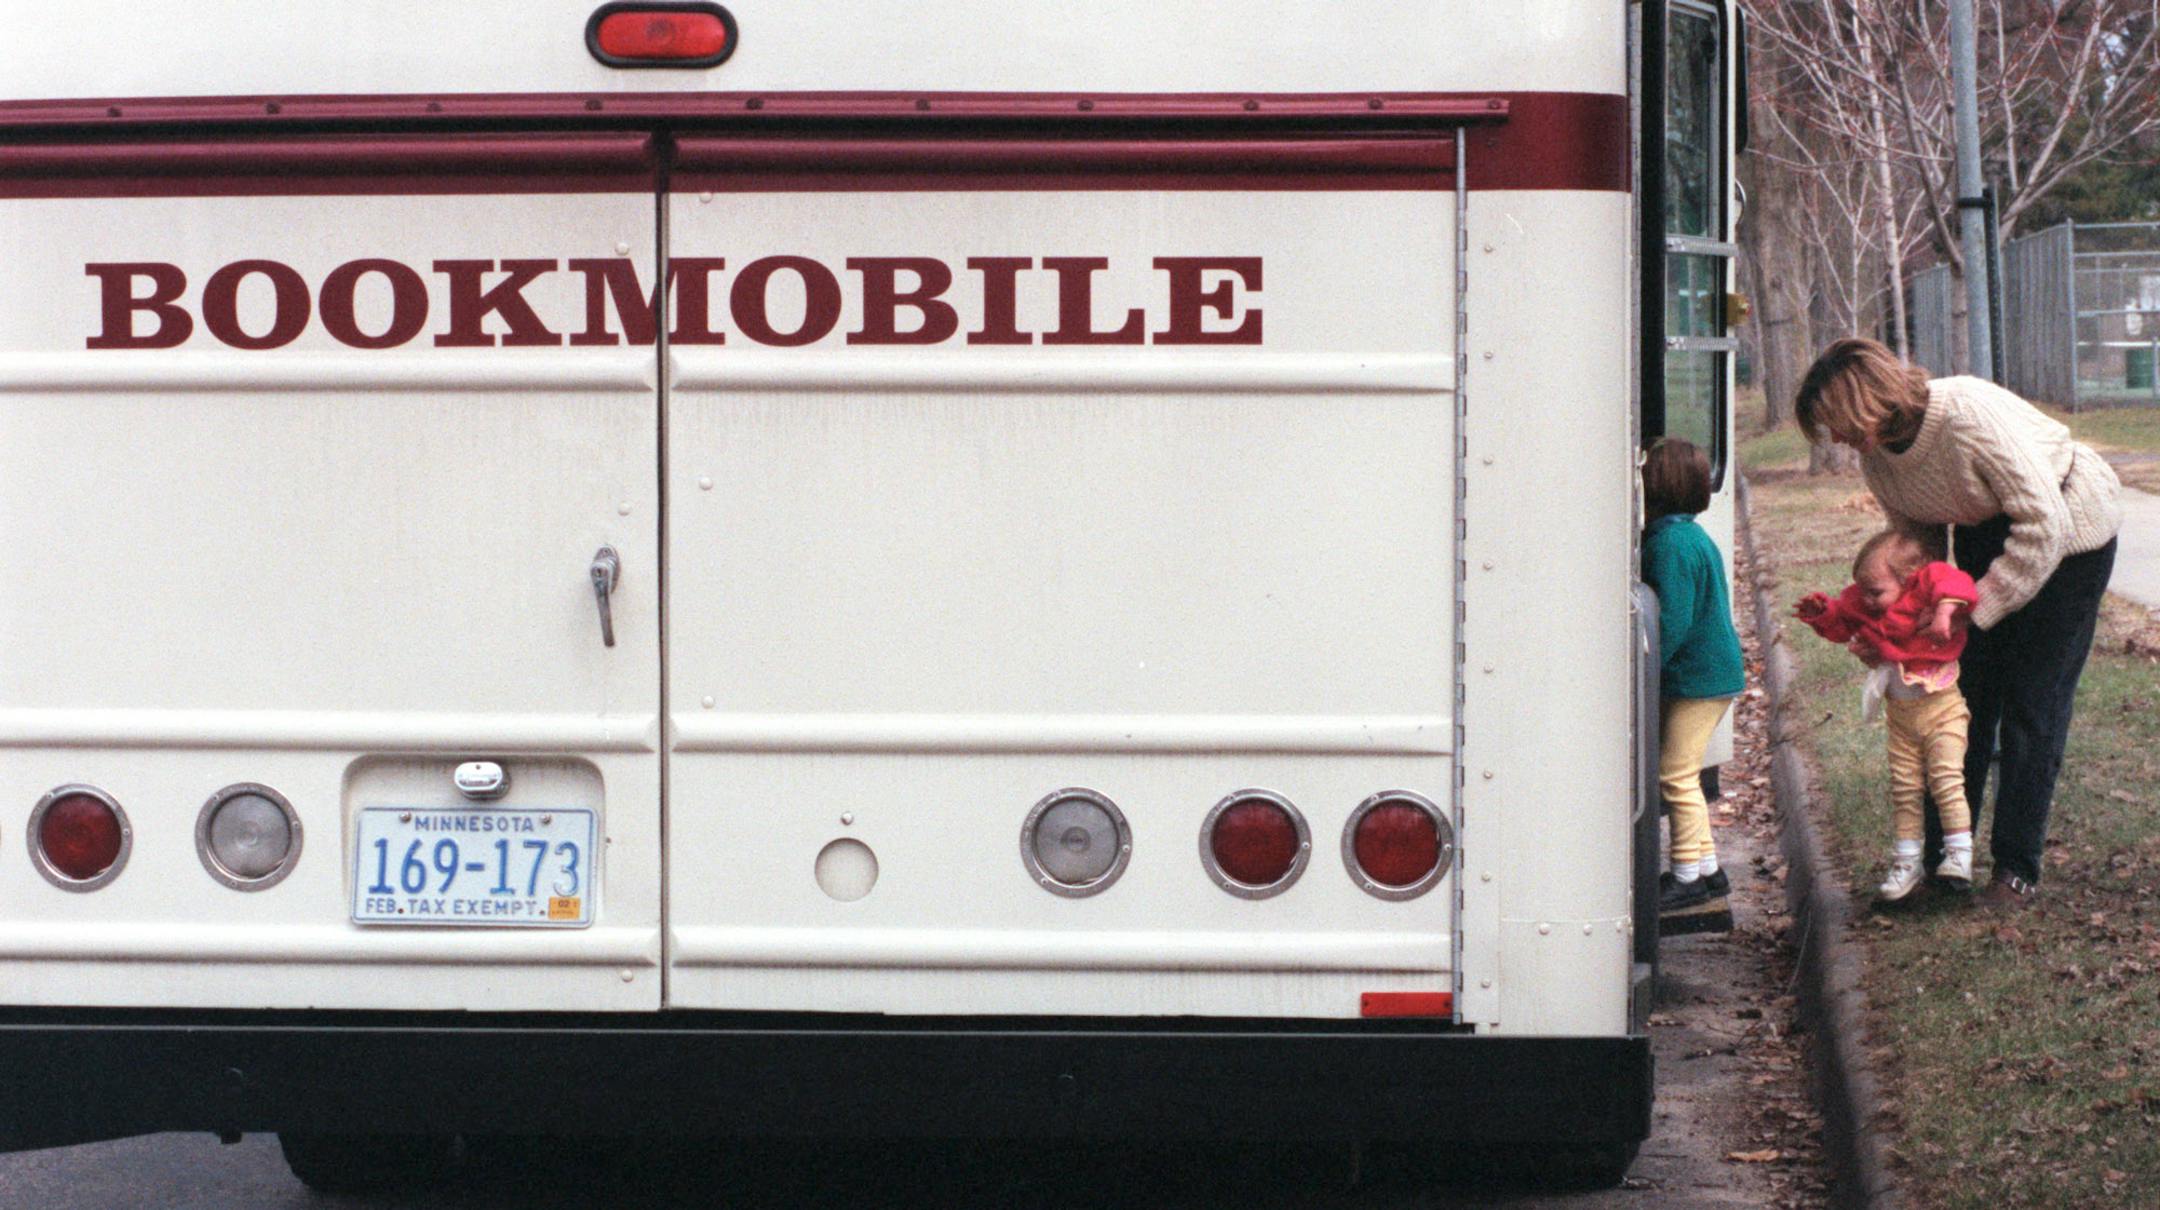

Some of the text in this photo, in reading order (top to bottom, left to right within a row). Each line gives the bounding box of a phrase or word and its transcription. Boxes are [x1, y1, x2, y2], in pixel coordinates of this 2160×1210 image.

[86, 256, 1262, 349] BOOKMOBILE
[414, 815, 535, 833] MINNESOTA
[368, 837, 580, 897] 169-173
[407, 898, 446, 915] TAX
